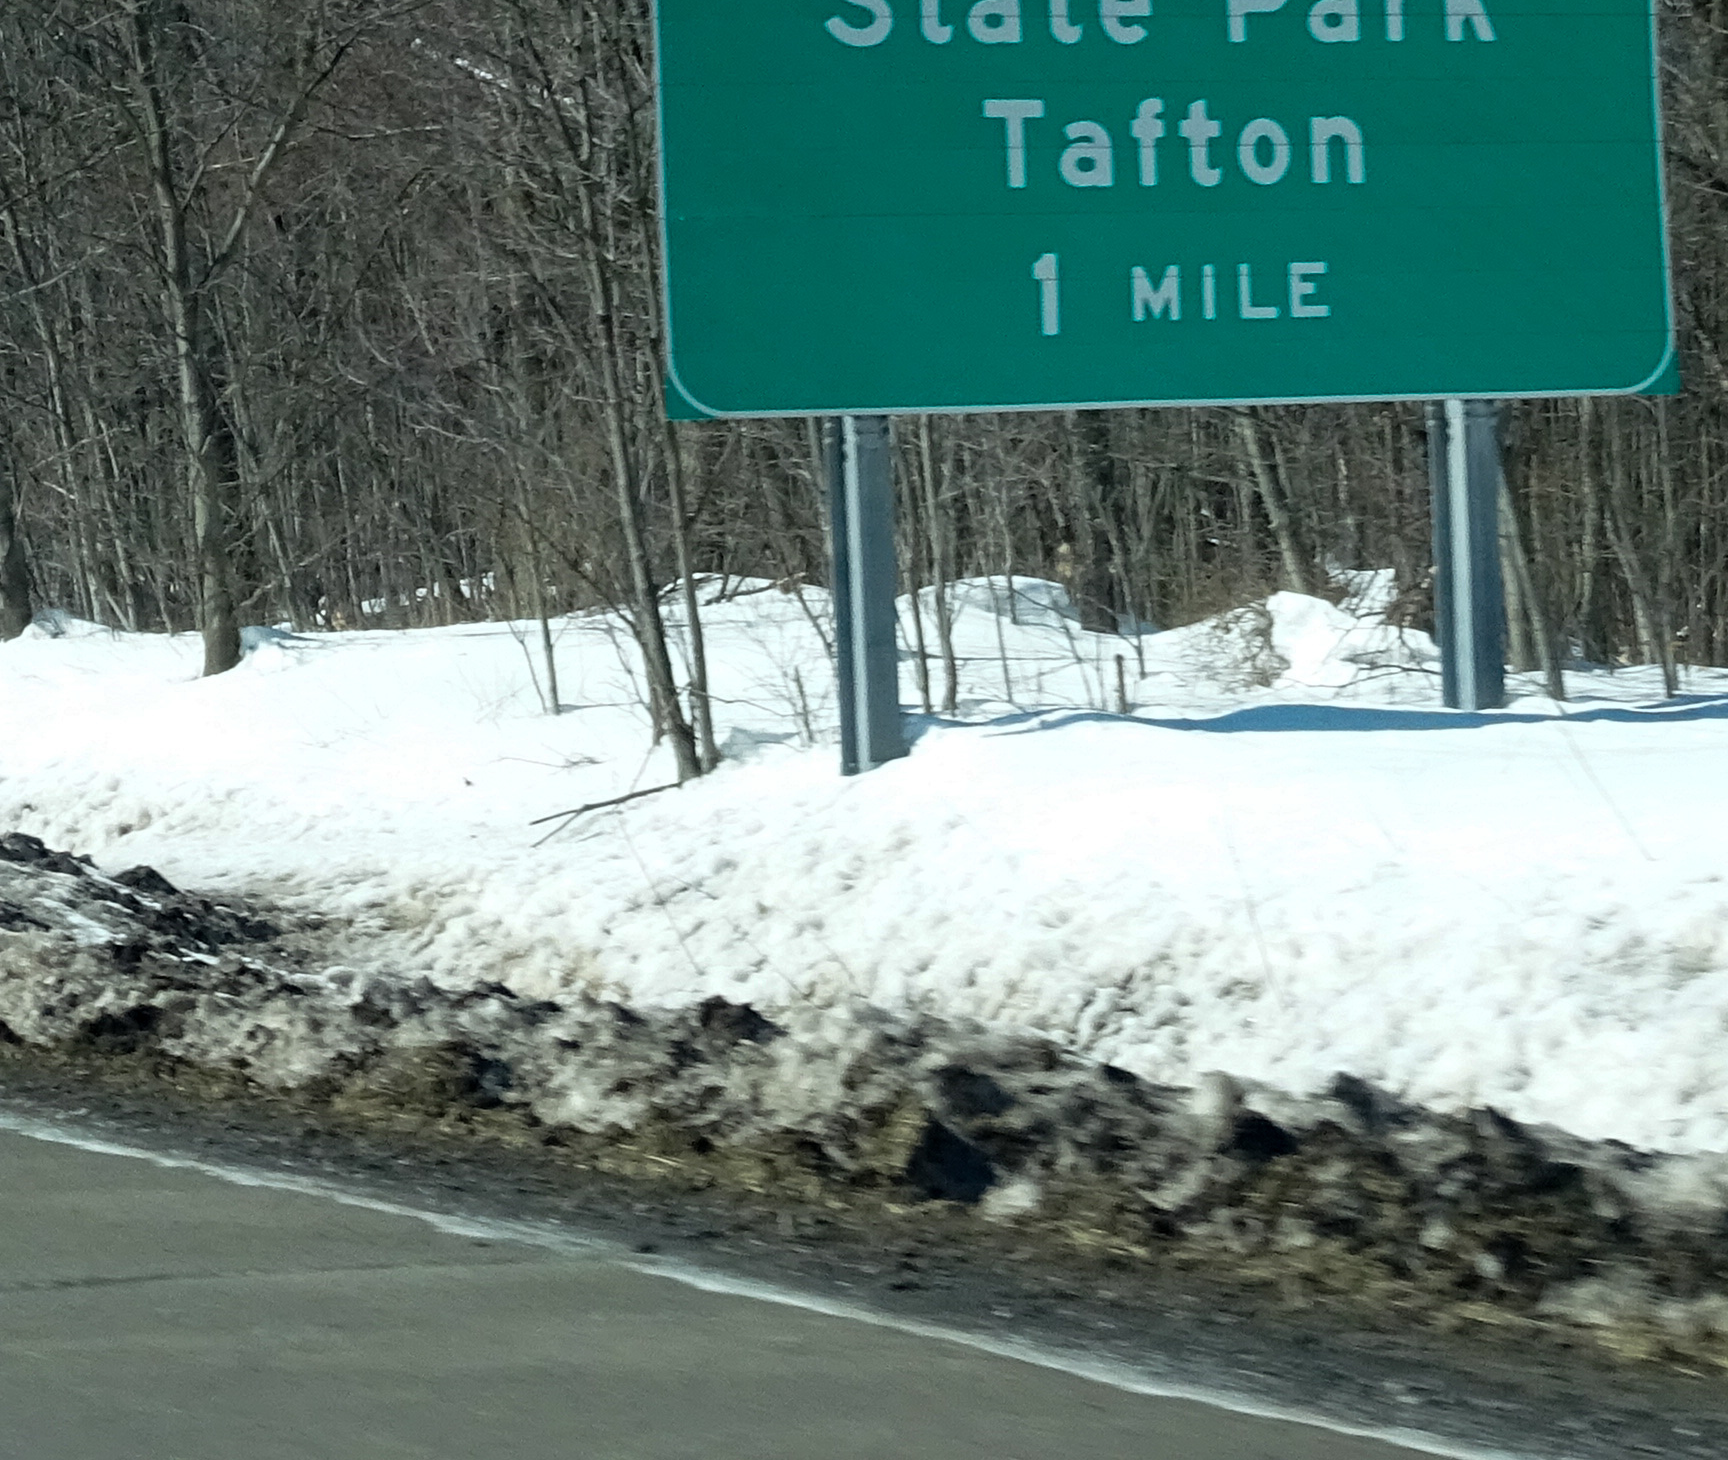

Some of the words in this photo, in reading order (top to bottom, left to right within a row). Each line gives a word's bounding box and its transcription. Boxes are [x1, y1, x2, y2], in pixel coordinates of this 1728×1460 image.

[983, 99, 1367, 188] Tafton
[1032, 253, 1060, 336] 1
[1131, 261, 1331, 322] MILE
